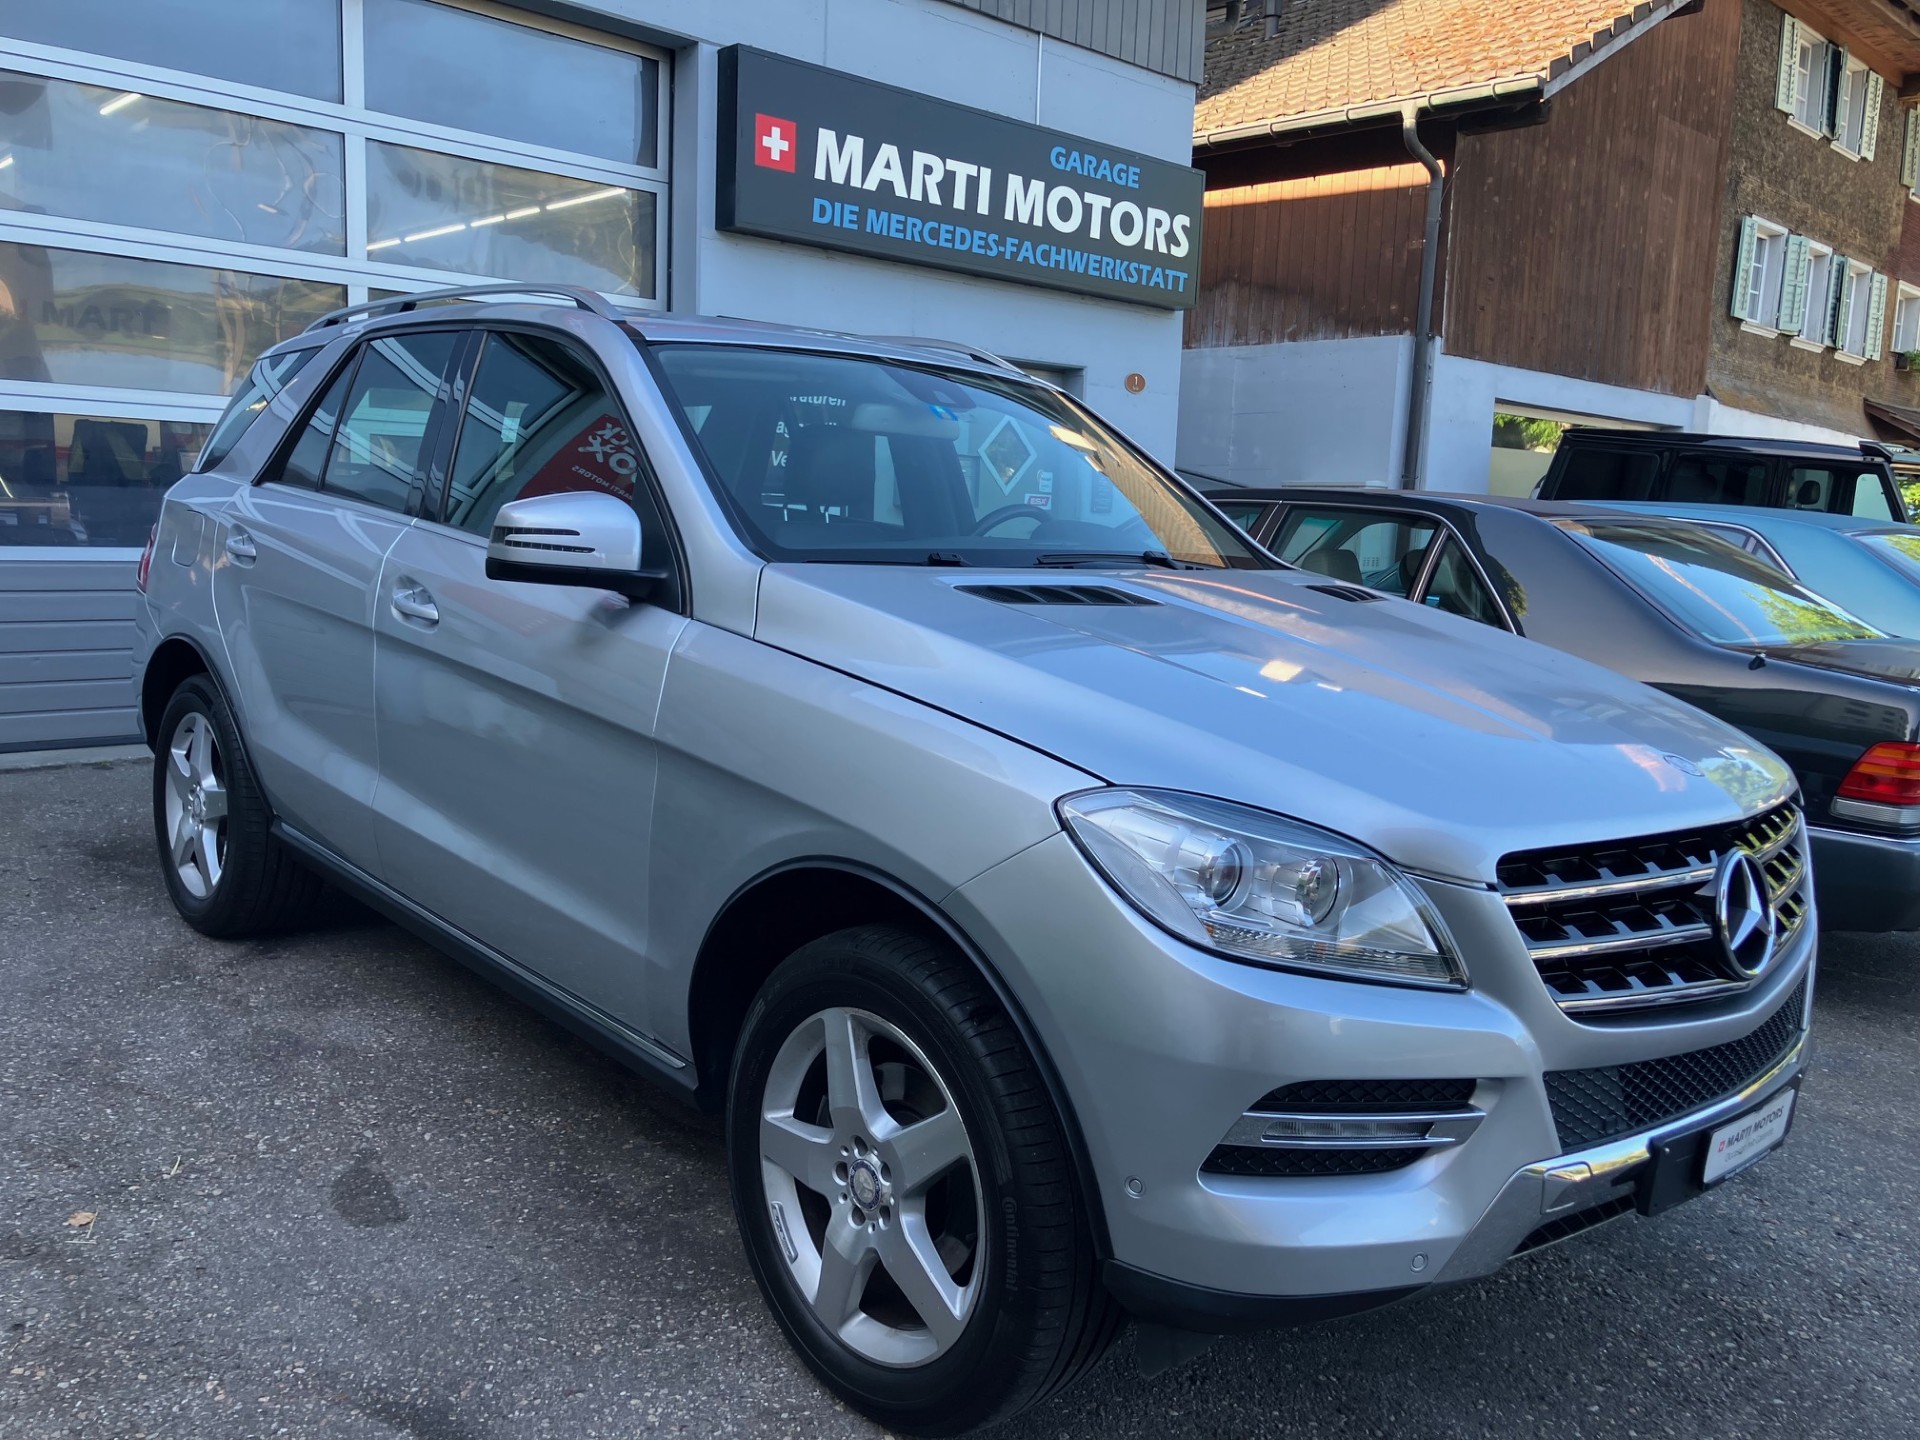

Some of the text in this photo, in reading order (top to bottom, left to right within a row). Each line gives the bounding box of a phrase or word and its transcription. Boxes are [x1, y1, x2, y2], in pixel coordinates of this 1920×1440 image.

[814, 127, 1191, 258] MARTI MOTORS
[1050, 146, 1141, 189] GARAGE
[812, 197, 1188, 293] DIE MERCEDES-FACHWERKSTATT
[1726, 1124, 1753, 1148] MARTI
[1752, 1105, 1785, 1133] MOTORS
[1002, 1196, 1019, 1292] Continental
